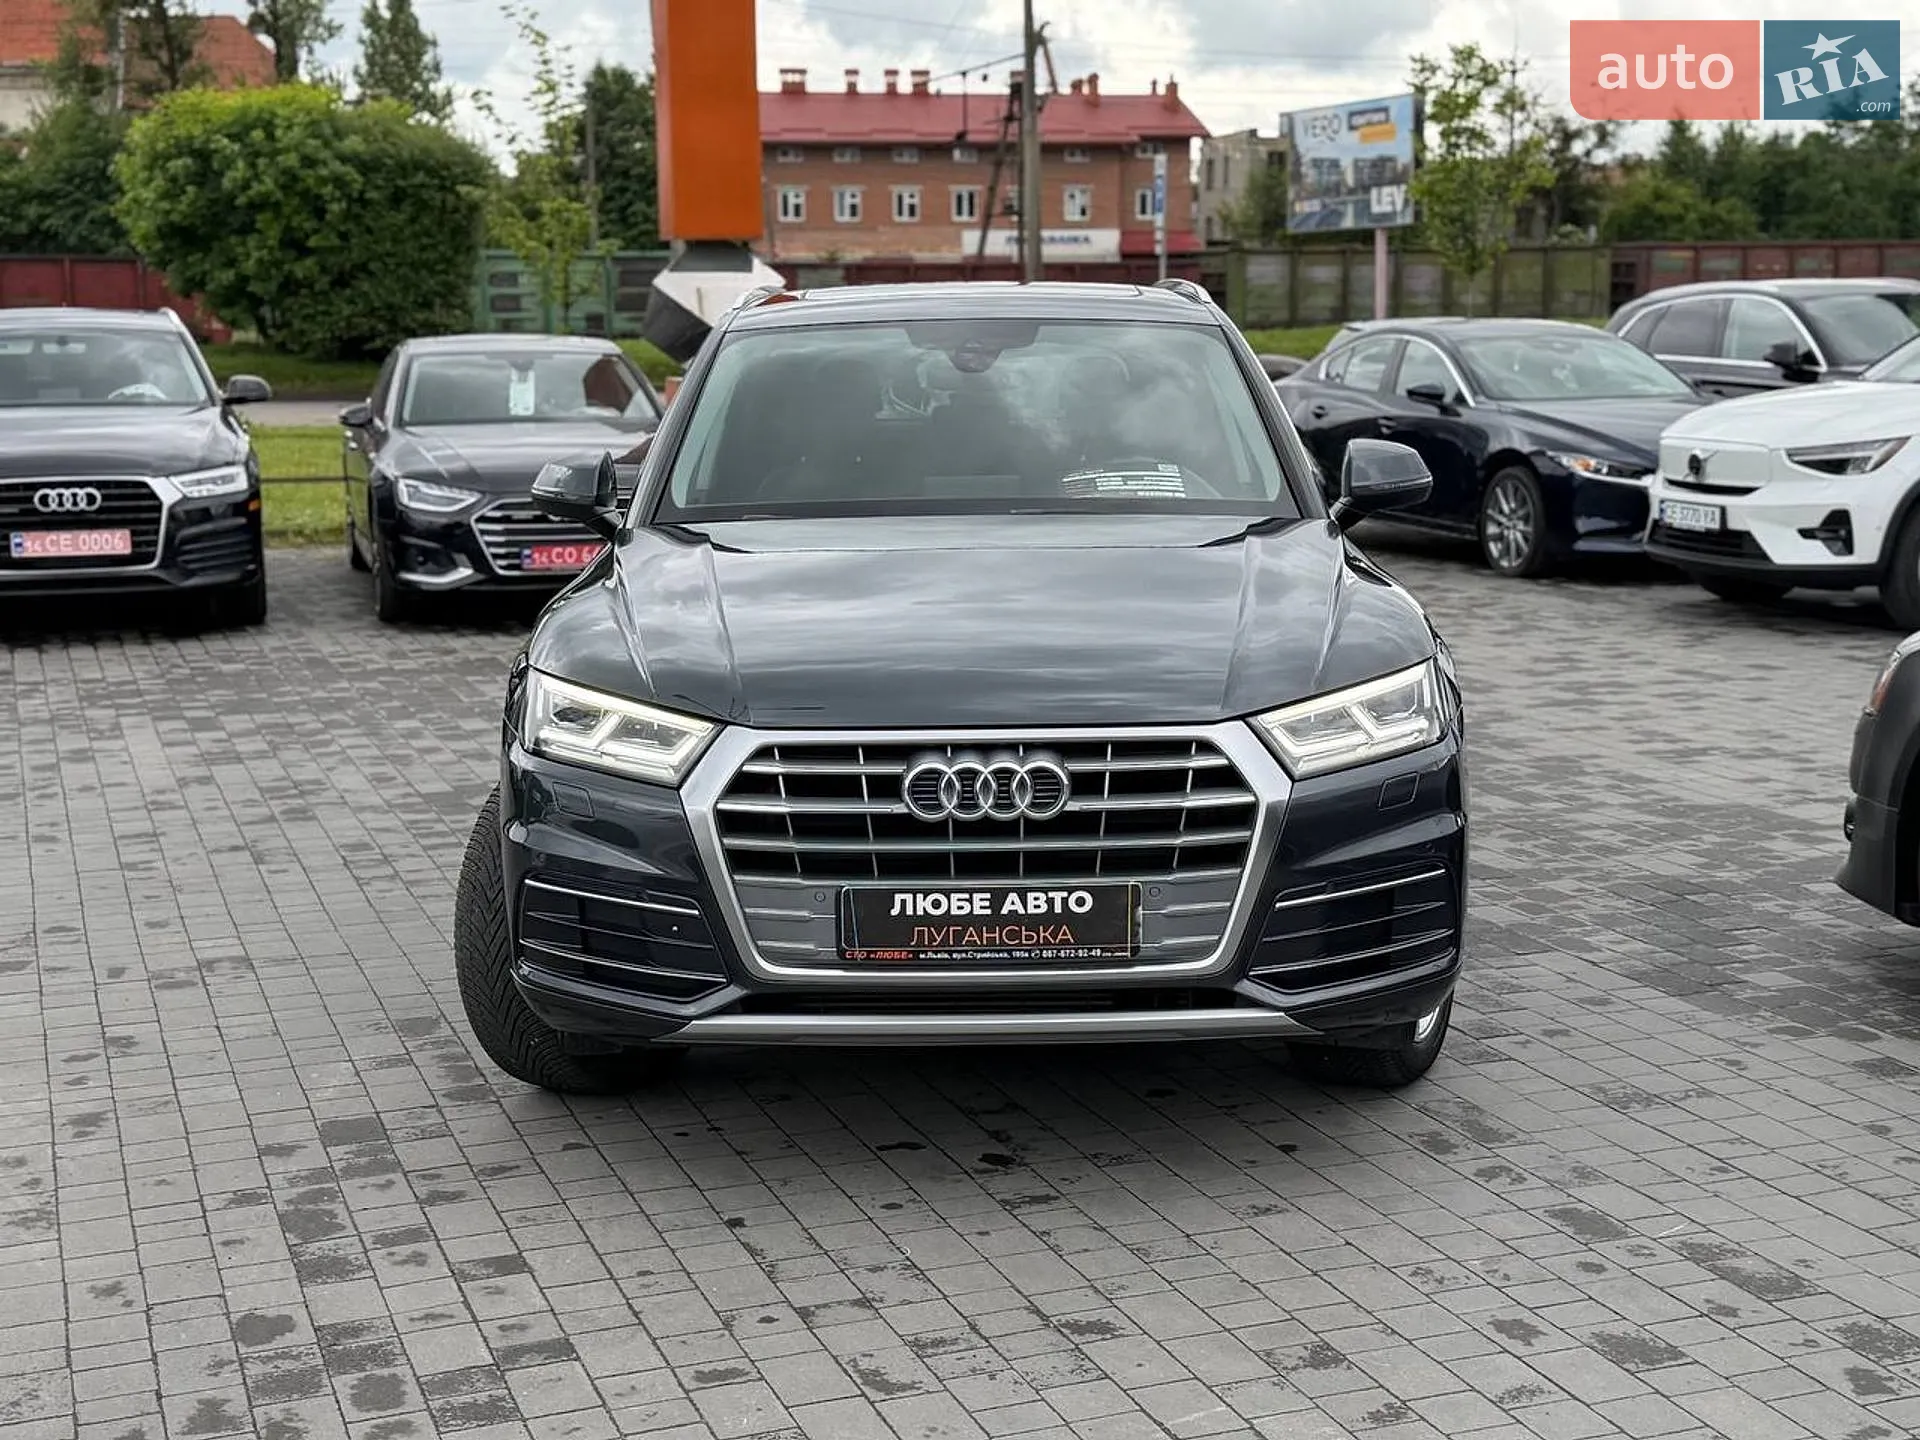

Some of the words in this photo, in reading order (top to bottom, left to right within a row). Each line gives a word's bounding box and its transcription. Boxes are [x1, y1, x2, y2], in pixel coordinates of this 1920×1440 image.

[45, 533, 73, 552] CE
[79, 531, 125, 552] 0006
[551, 546, 577, 564] CO
[890, 891, 992, 916] ЛЮБЕ
[1000, 890, 1093, 915] АВТО
[910, 924, 1075, 946] ЛУГАНСЬКА
